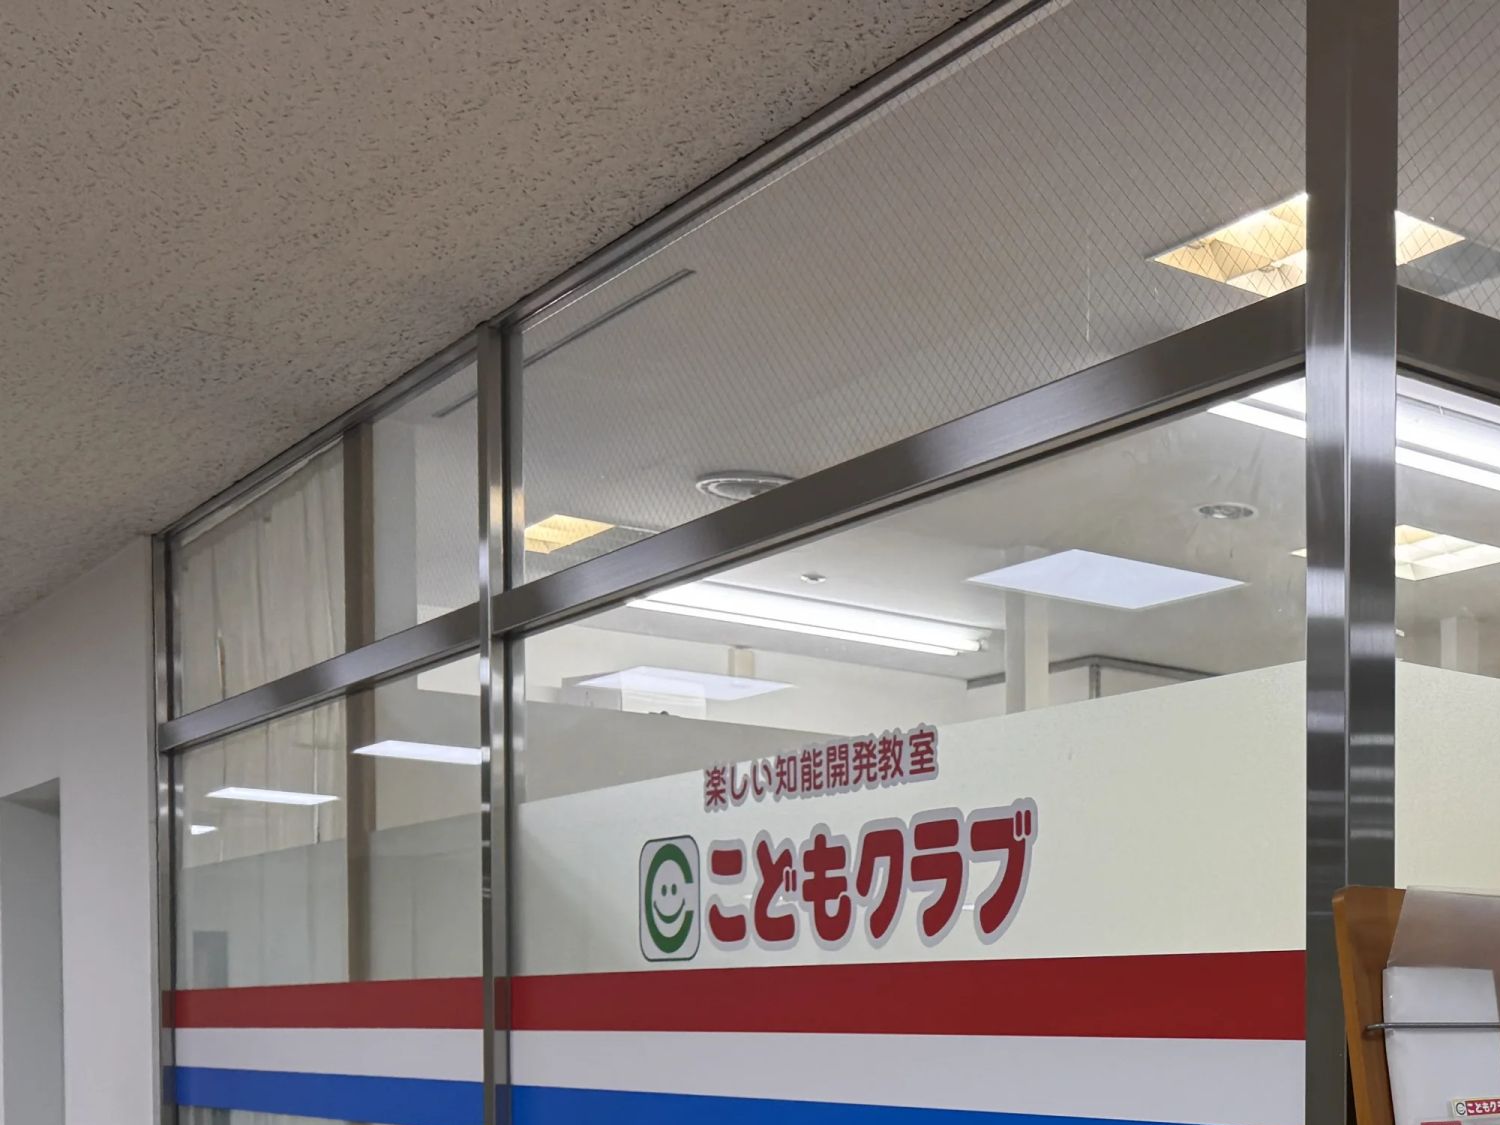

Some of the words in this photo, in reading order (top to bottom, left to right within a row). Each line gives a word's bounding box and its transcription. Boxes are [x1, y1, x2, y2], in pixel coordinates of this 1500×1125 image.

[704, 727, 937, 808] 楽しい知能開発教室
[707, 806, 1034, 945] こどもクラブ
